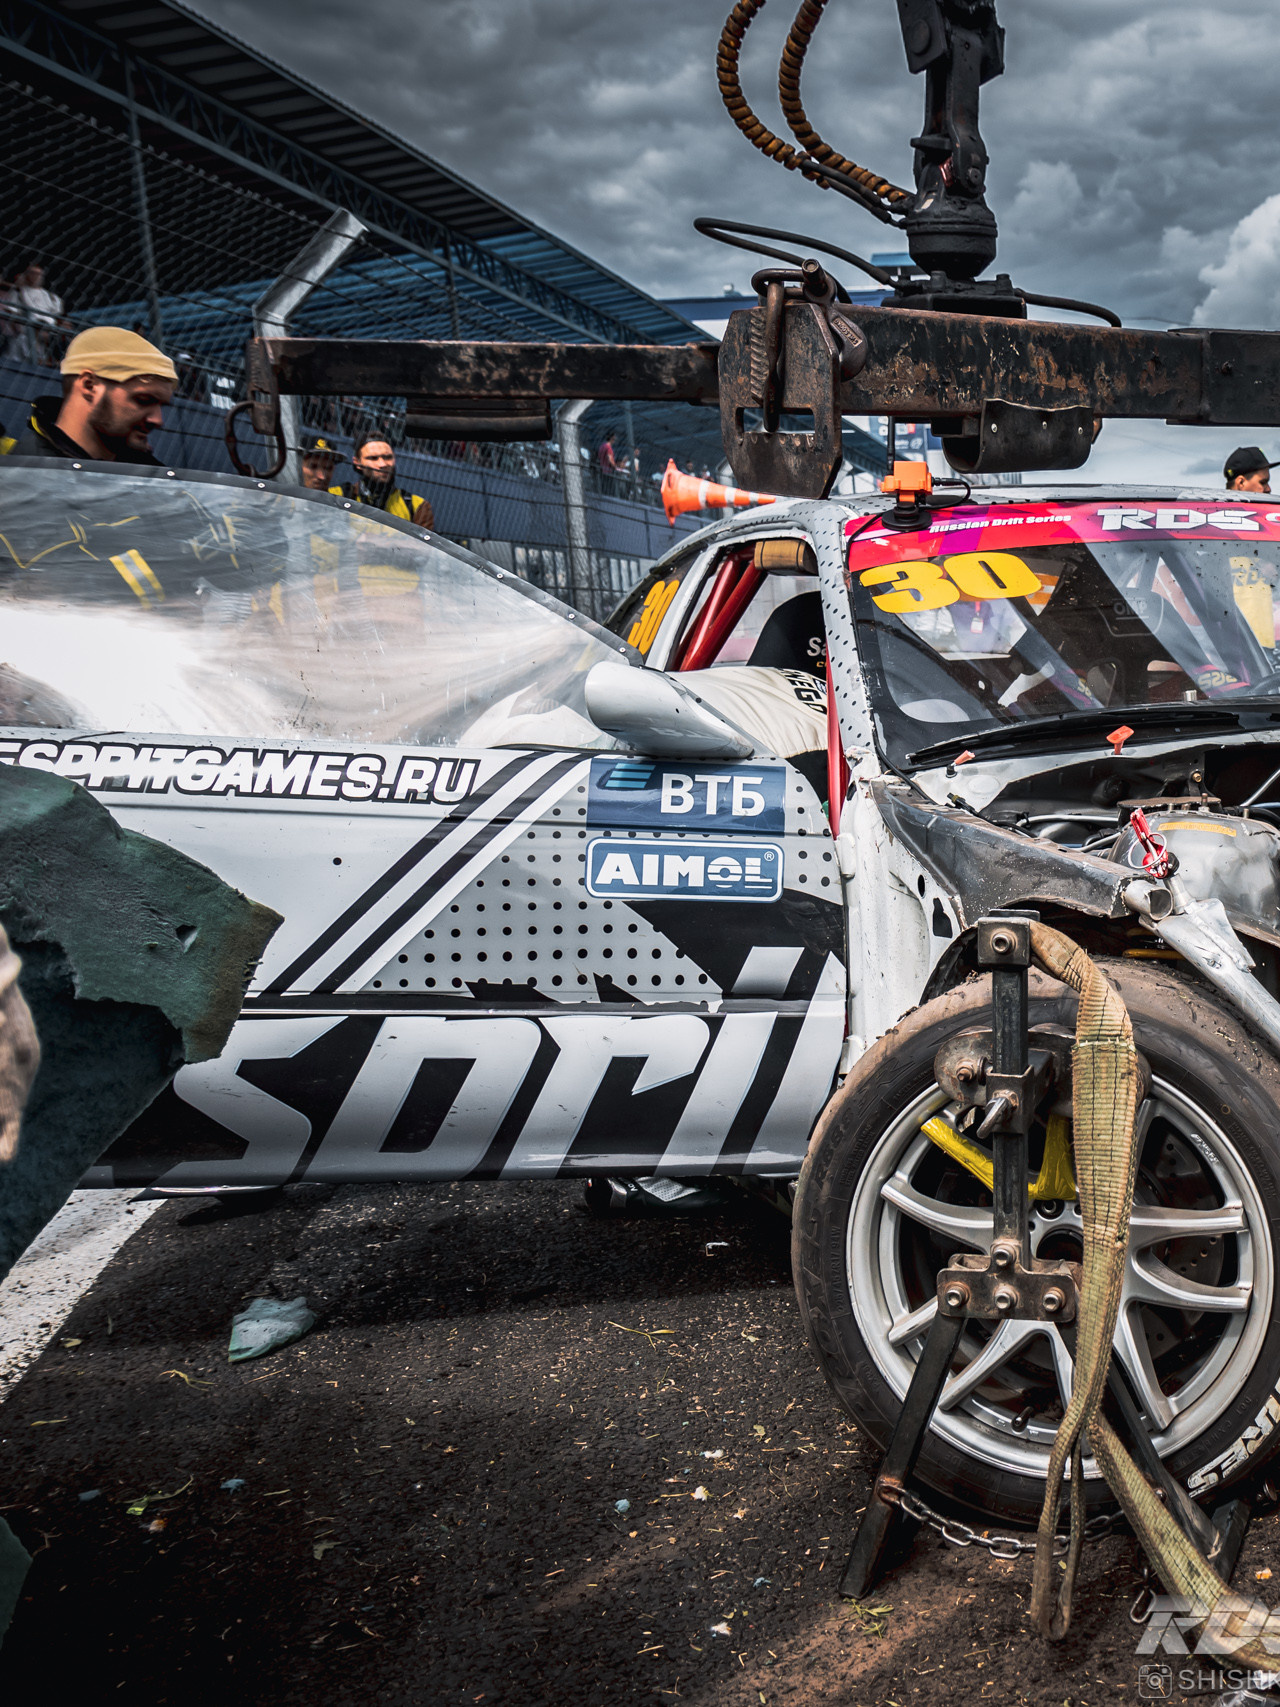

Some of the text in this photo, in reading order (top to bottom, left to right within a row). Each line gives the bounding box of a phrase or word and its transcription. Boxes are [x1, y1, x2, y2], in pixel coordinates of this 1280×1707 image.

[929, 514, 1072, 534] Russian Drift Series
[1097, 508, 1260, 531] RDS
[859, 552, 1042, 613] 30
[626, 580, 680, 655] 30
[660, 772, 766, 817] ВТБ
